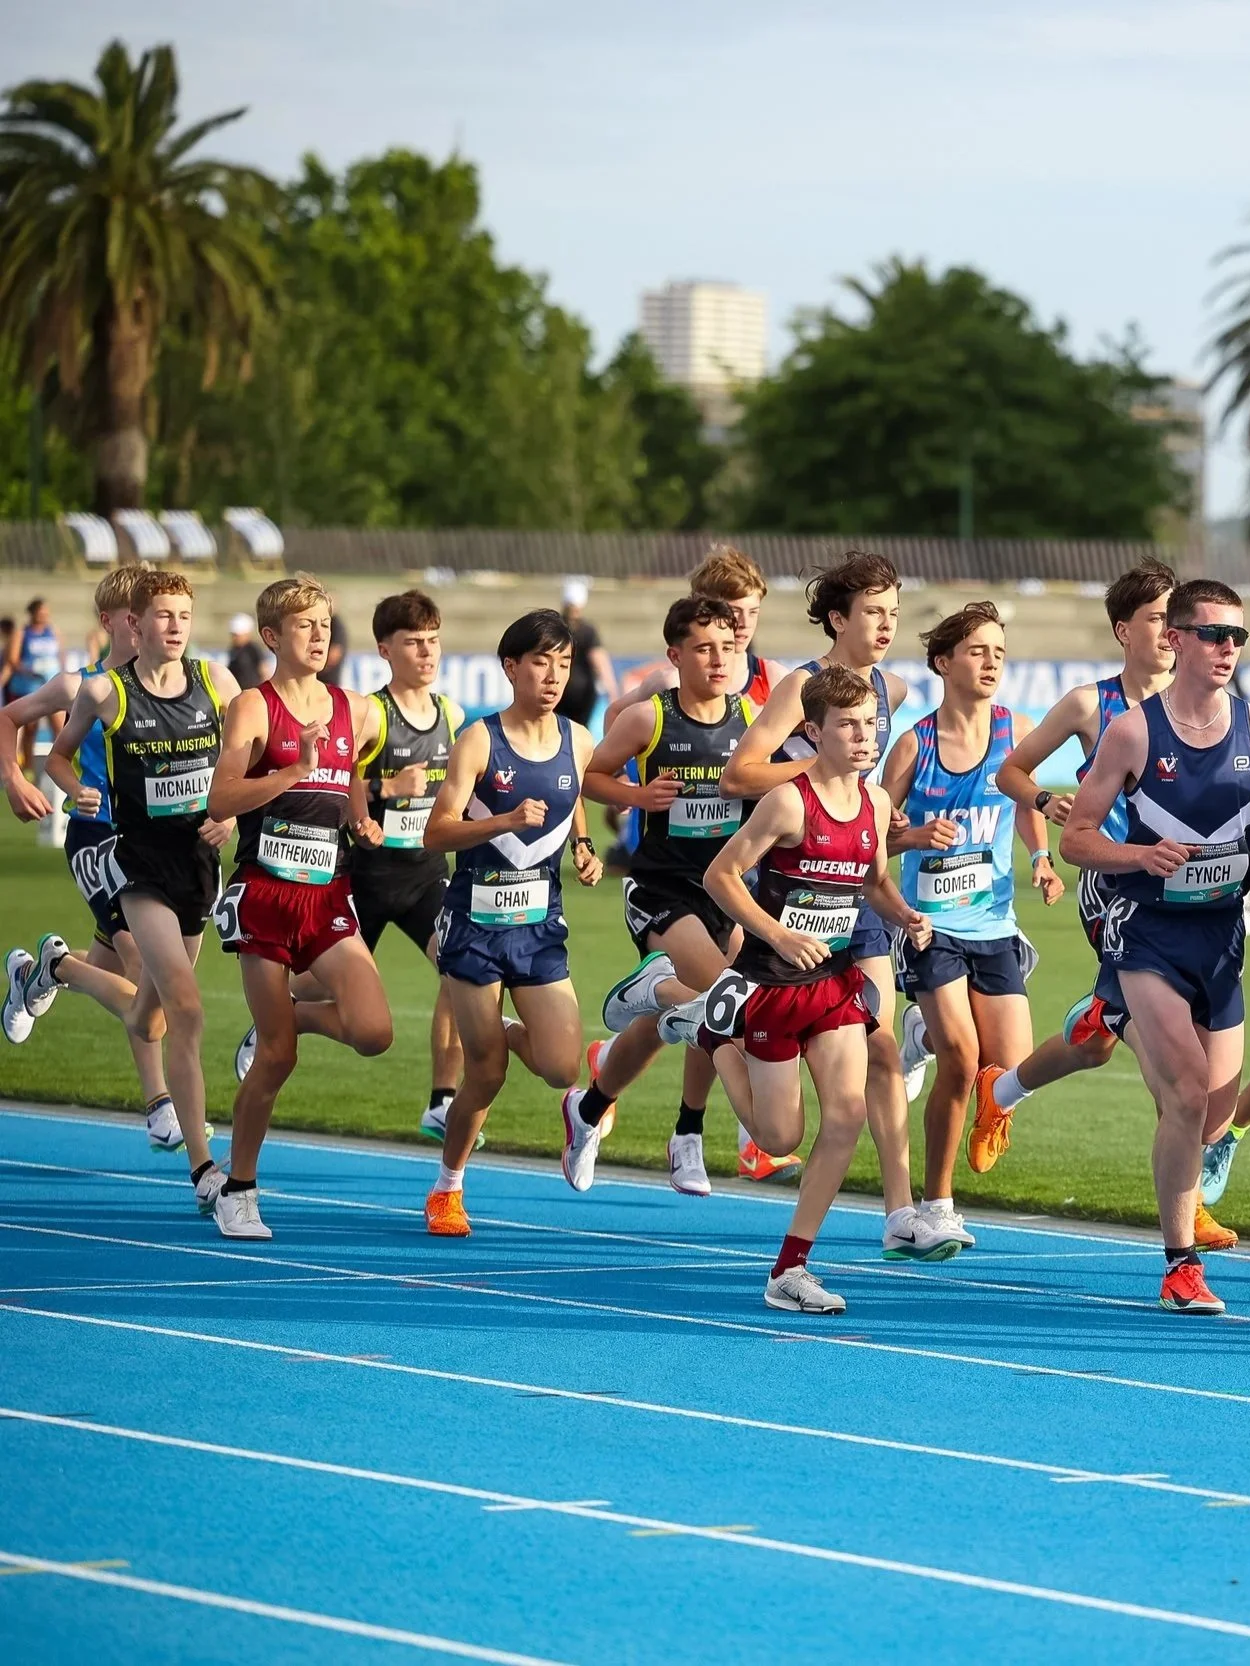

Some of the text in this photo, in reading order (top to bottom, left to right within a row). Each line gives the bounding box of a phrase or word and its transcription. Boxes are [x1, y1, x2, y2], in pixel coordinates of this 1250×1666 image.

[135, 719, 156, 728] VALOUR
[124, 734, 217, 755] WESTERN AUSTRALIA
[669, 743, 692, 752] VALOUR
[155, 776, 210, 798] MCNALLY
[686, 803, 730, 820] WYNNE
[263, 839, 333, 868] MATHEWSON
[934, 873, 976, 895] COMER
[1185, 864, 1231, 884] FYNCH
[494, 890, 529, 908] CHAN
[786, 911, 851, 933] SCHINARD
[706, 975, 749, 1032] 6
